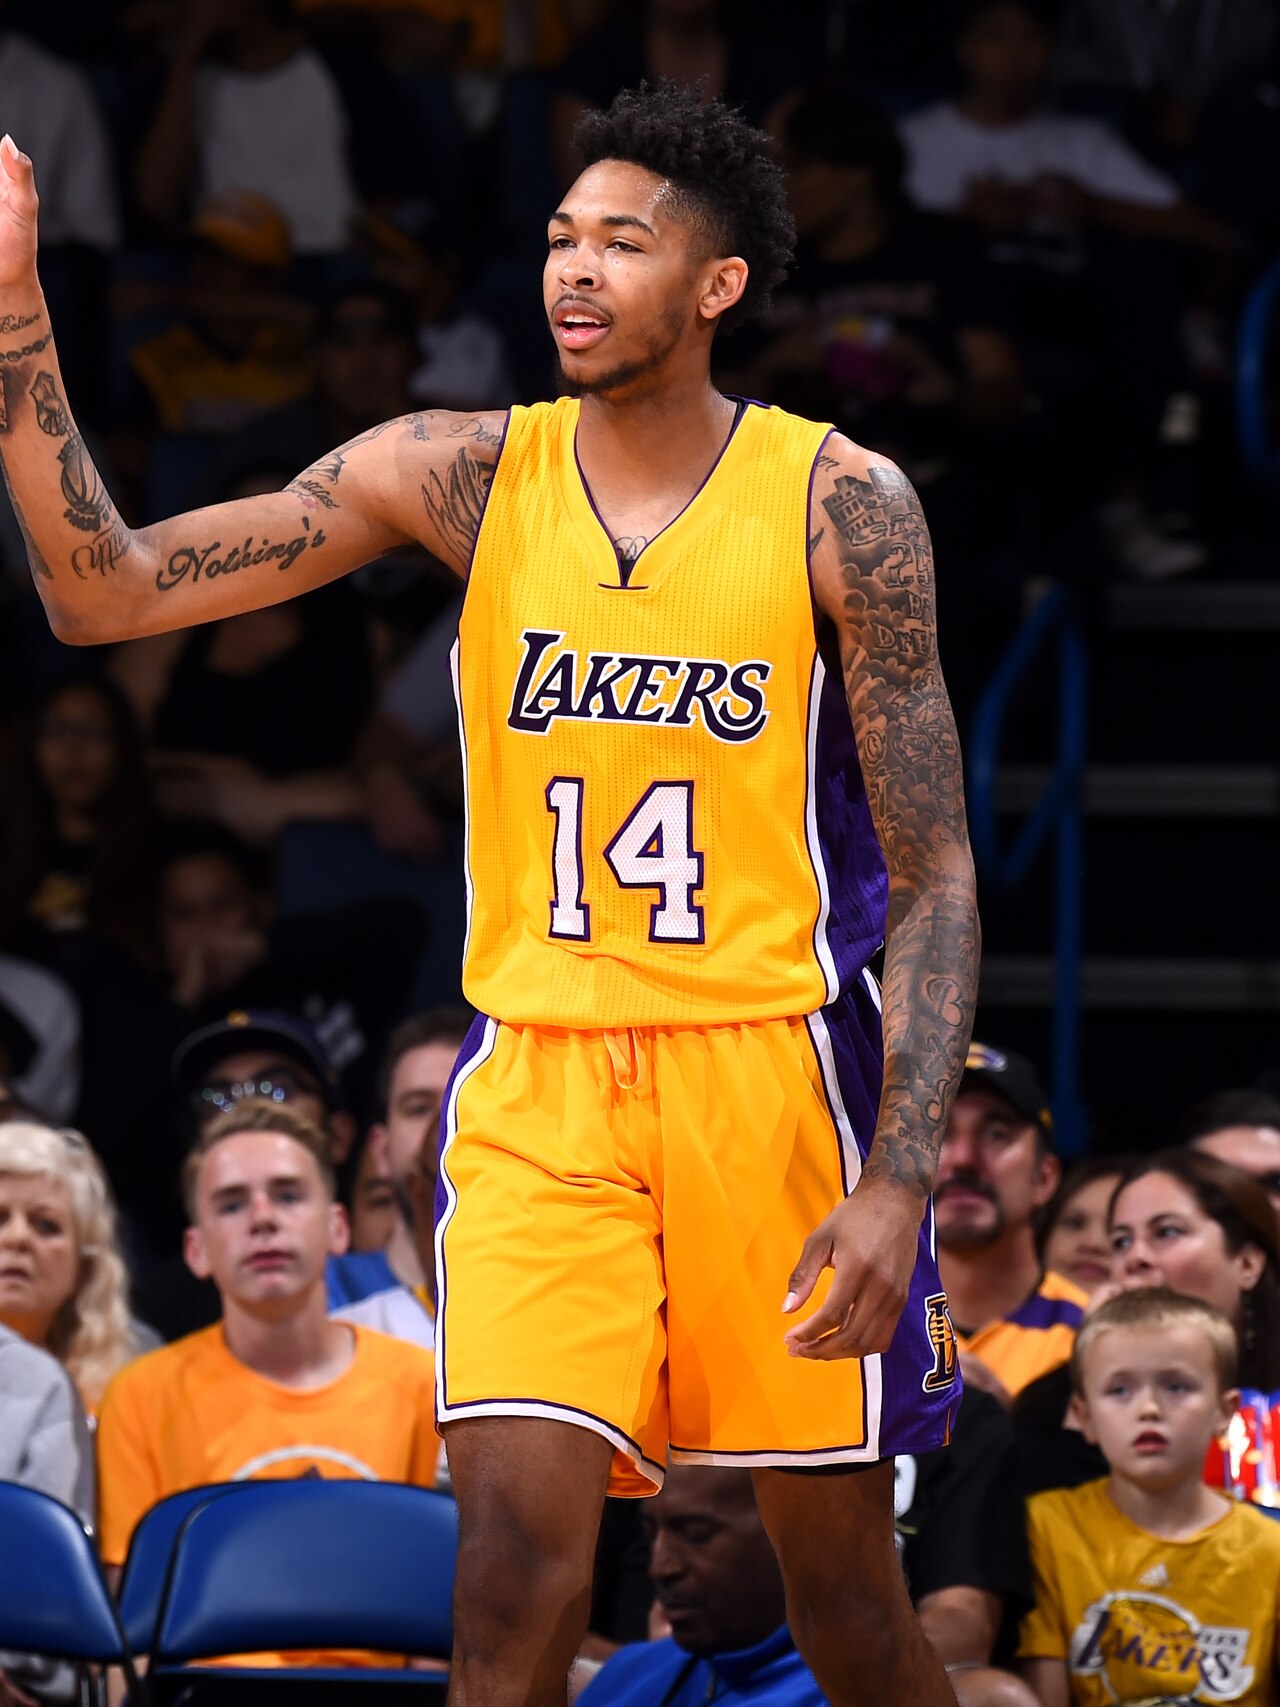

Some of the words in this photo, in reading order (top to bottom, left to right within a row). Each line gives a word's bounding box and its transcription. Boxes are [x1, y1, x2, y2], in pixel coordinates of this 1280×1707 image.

[156, 516, 326, 591] Nothing's
[507, 628, 774, 745] LAKERS
[544, 776, 705, 944] 14
